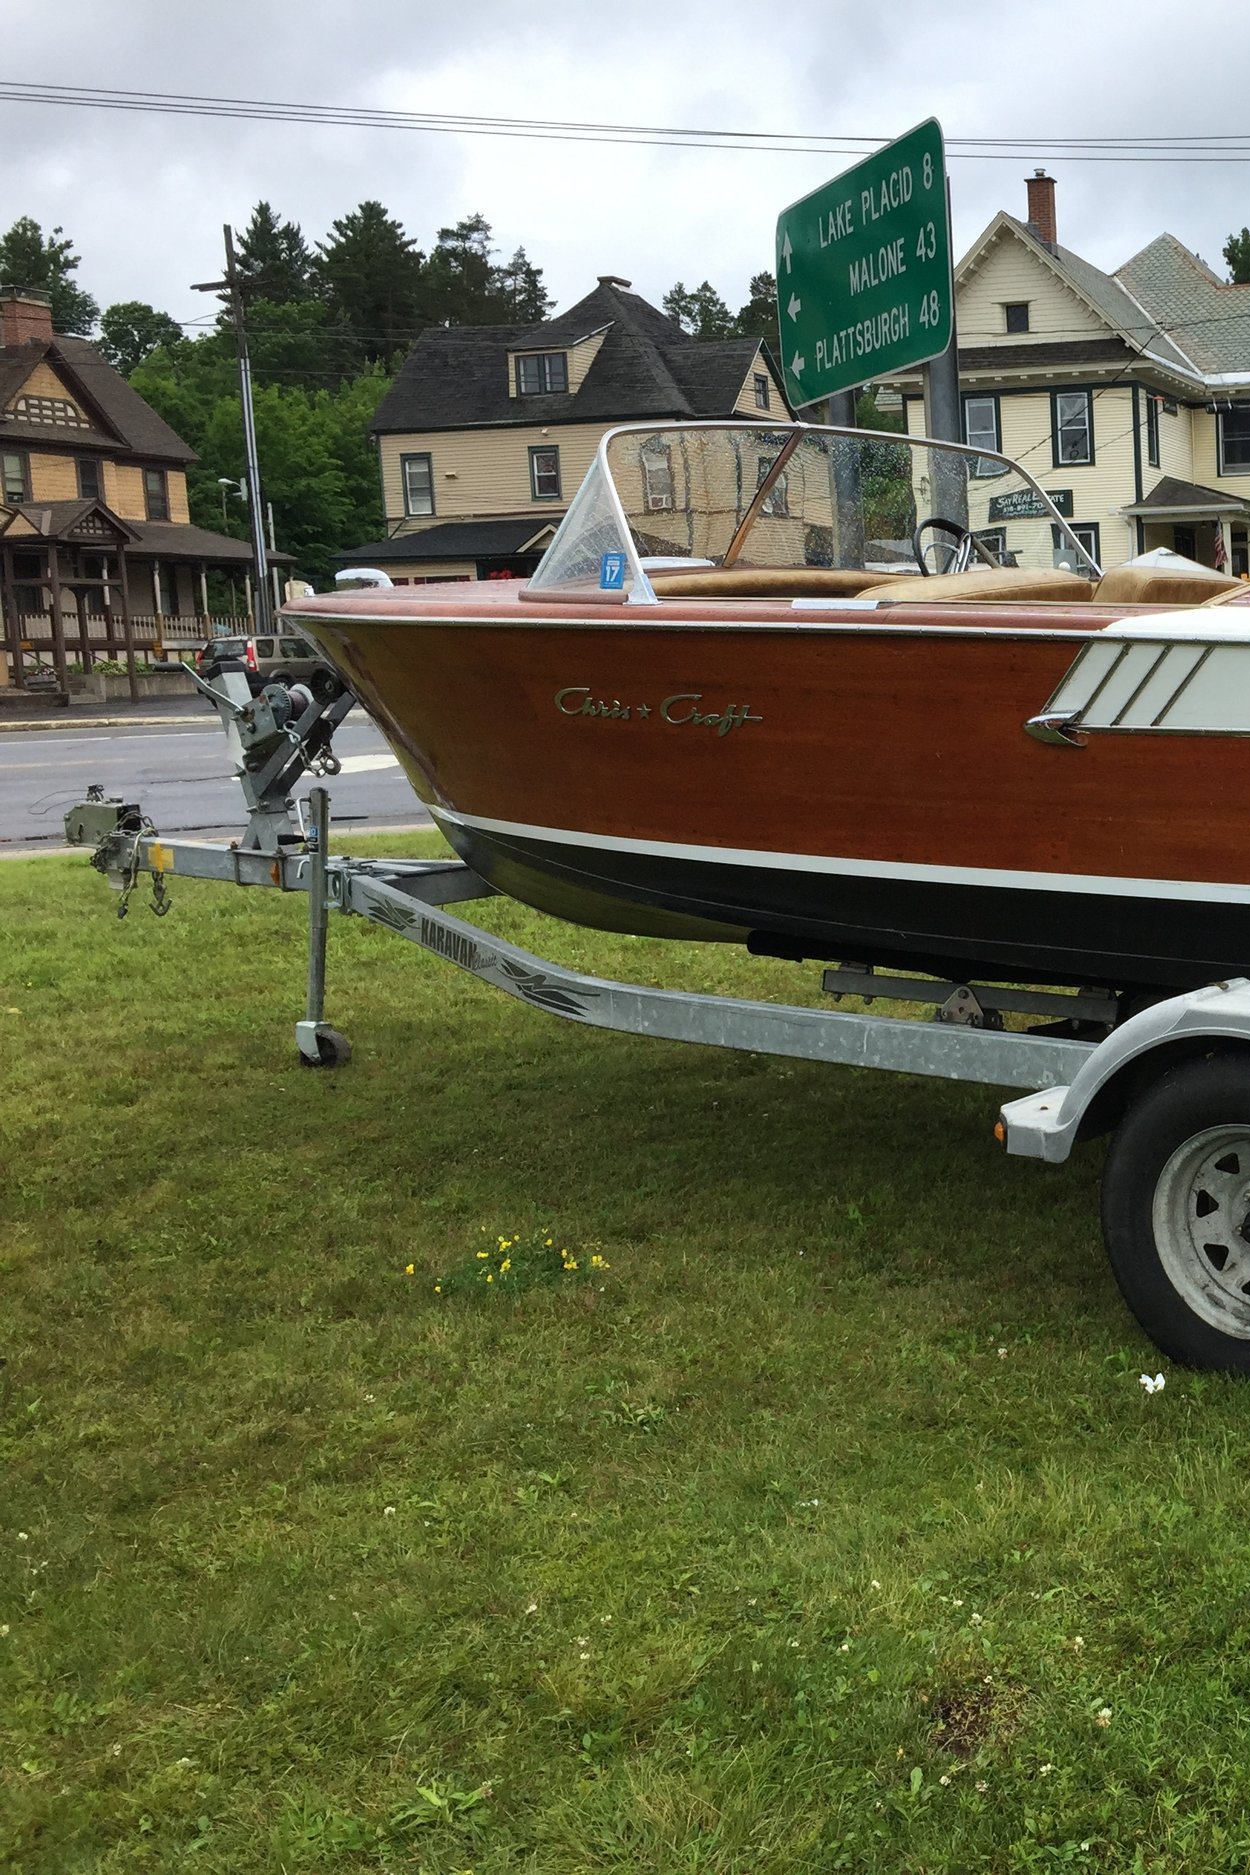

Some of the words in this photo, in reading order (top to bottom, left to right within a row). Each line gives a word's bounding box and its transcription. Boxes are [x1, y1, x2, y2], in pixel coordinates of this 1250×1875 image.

[819, 199, 854, 249] LAKE
[861, 165, 912, 227] PLACID
[923, 152, 933, 190] 8
[849, 237, 906, 297] MALONE
[916, 222, 937, 263] 43
[815, 303, 910, 373] PLATTSBURGH
[919, 289, 939, 330] 48
[605, 566, 620, 582] 17
